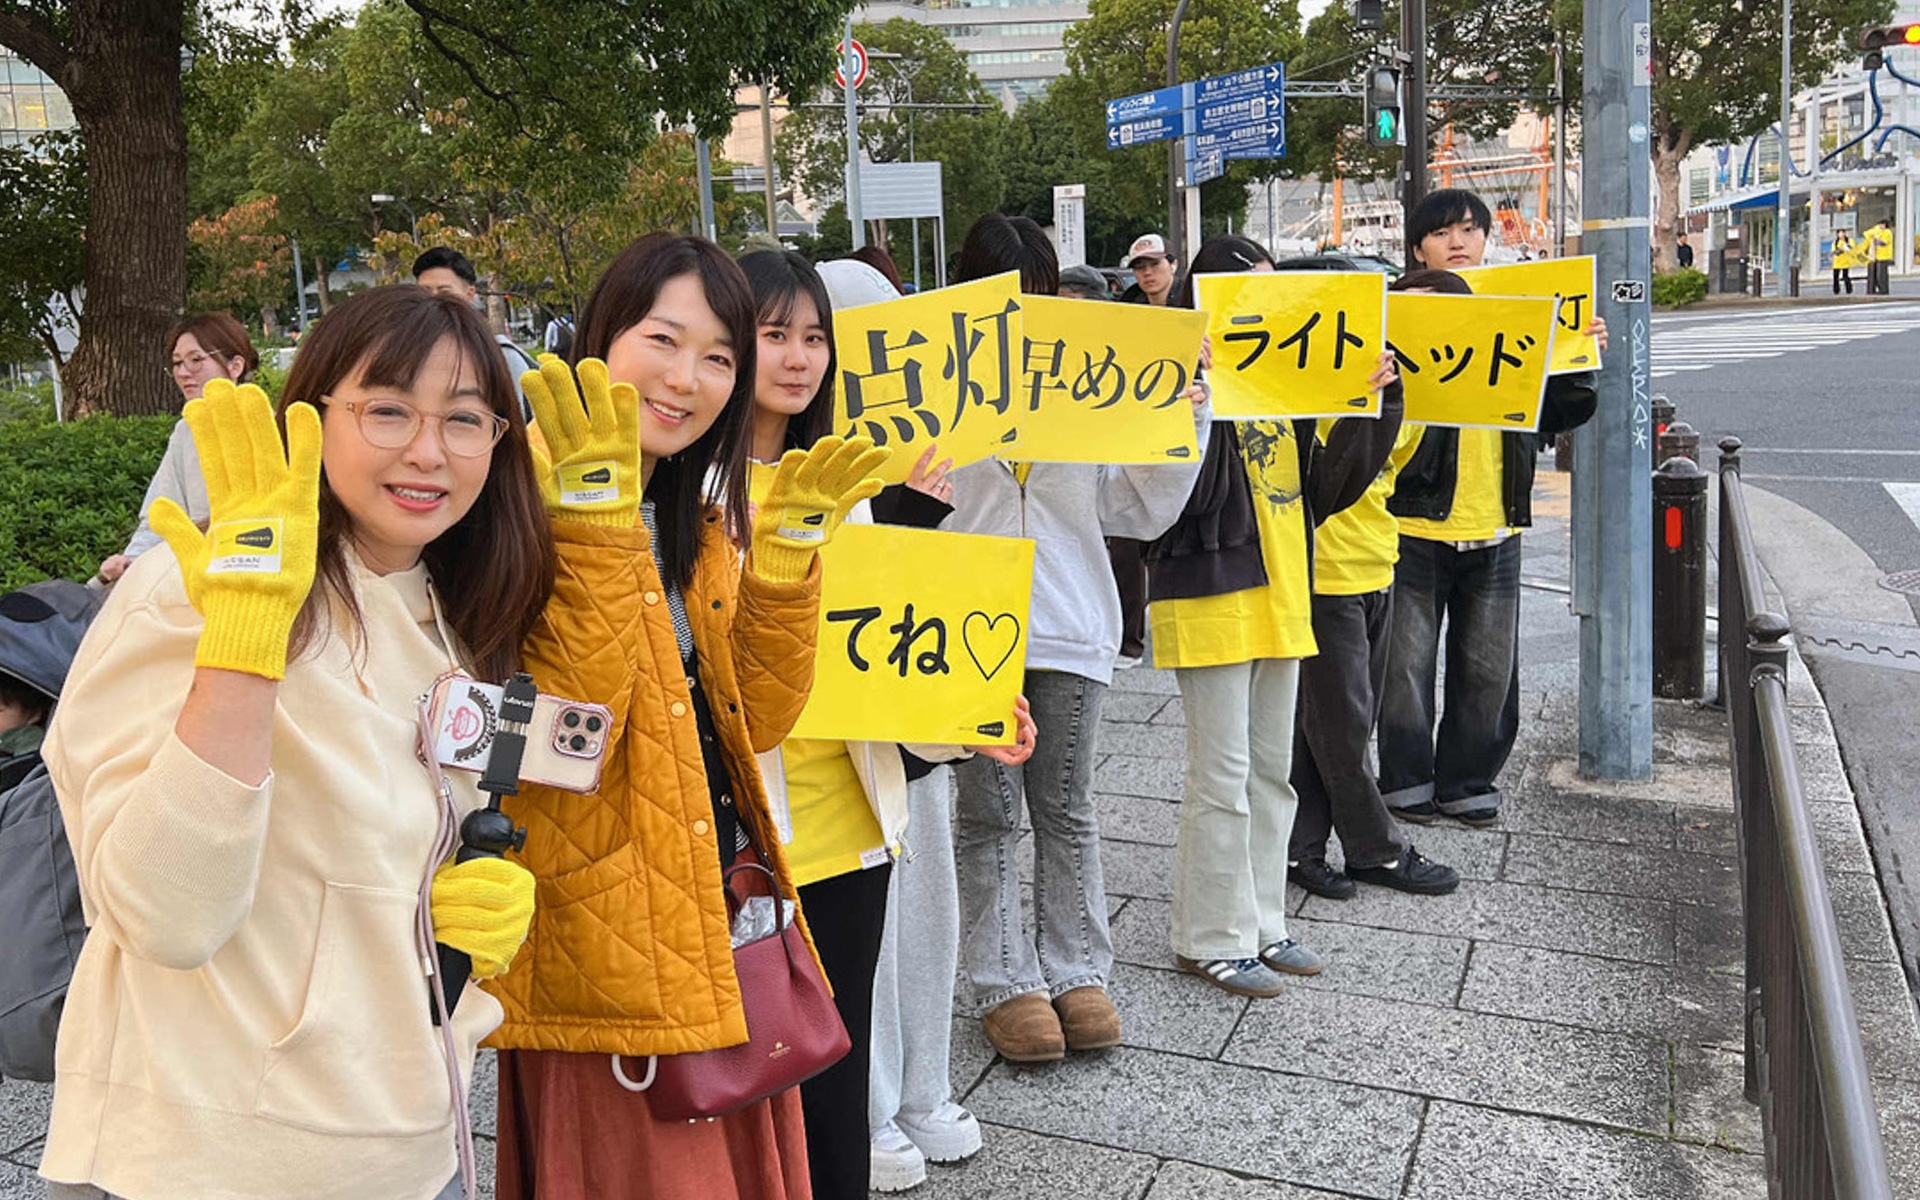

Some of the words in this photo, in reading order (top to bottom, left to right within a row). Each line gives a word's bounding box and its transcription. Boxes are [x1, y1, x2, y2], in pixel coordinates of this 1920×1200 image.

[842, 298, 1020, 447] 点灯
[1023, 336, 1186, 411] 早めの
[1224, 311, 1364, 371] ライト
[1385, 333, 1535, 386] ヘッド
[826, 603, 950, 678] てね
